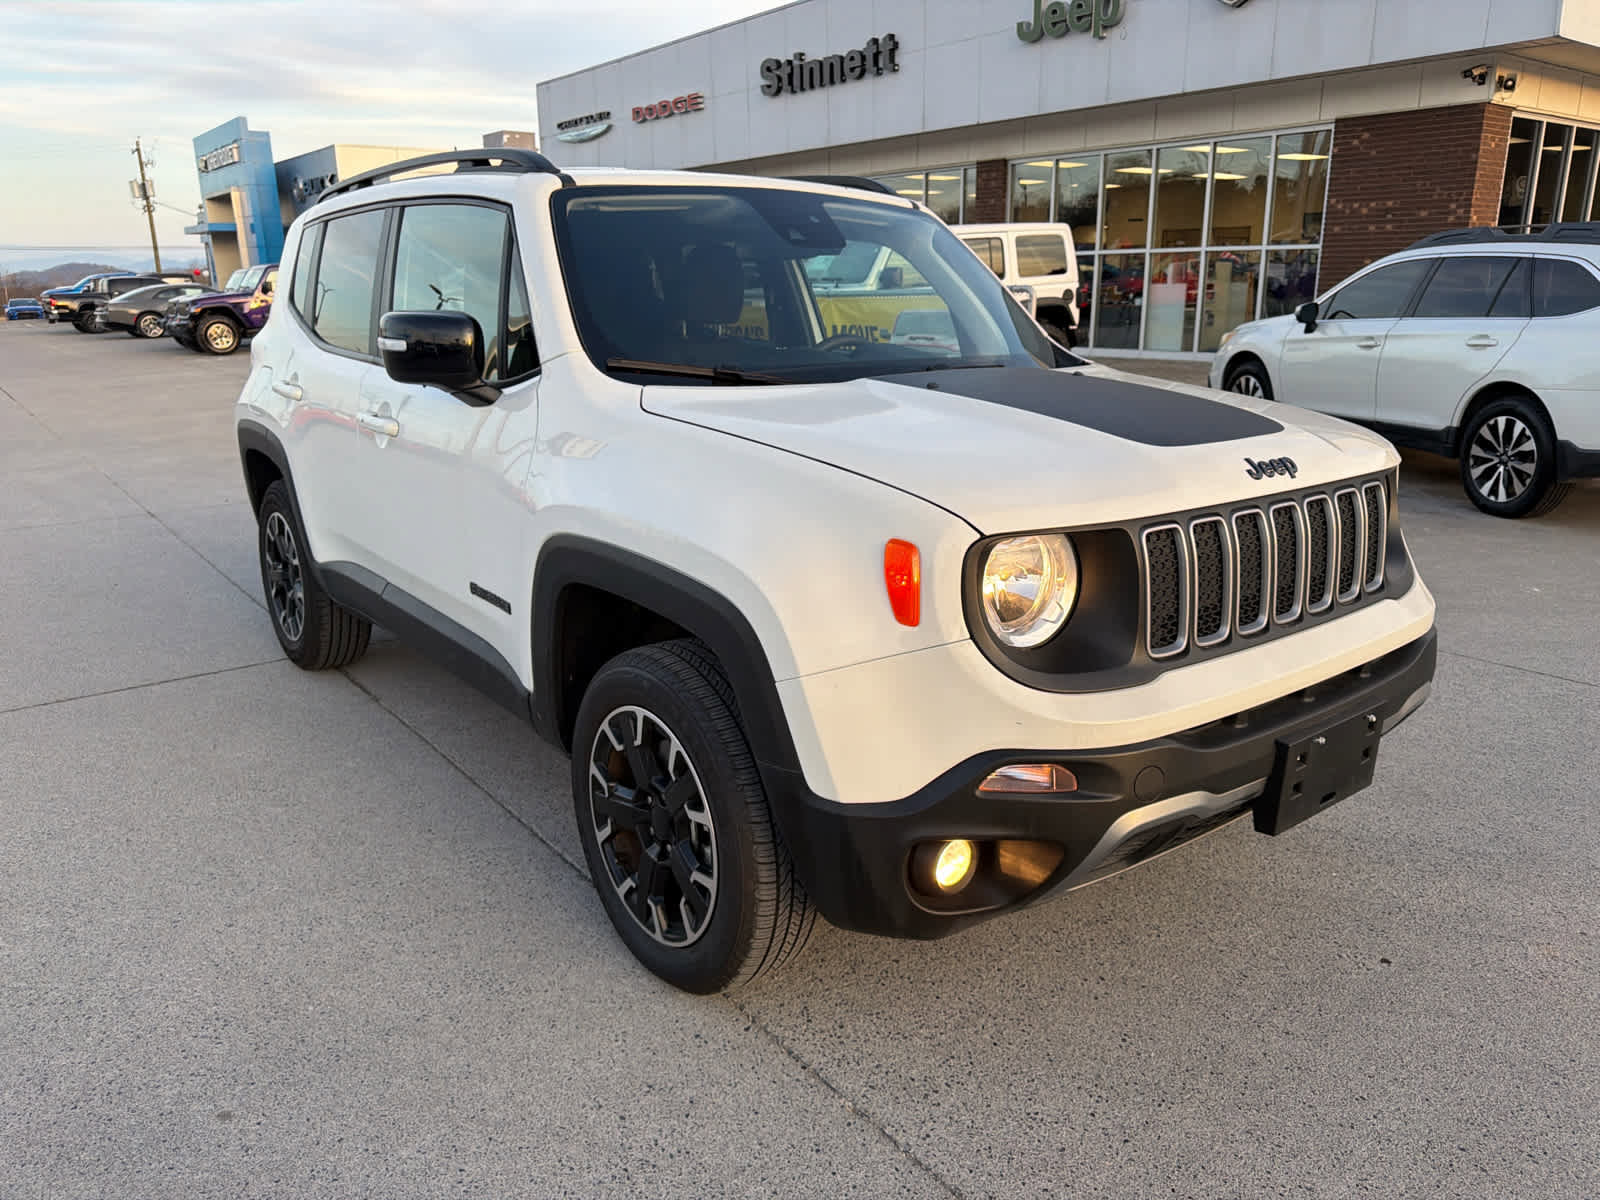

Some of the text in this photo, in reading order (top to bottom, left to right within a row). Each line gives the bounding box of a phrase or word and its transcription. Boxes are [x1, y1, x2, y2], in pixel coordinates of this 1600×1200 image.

[1016, 0, 1124, 43] Jeep
[760, 32, 899, 97] Stinnett
[631, 92, 705, 124] DODGE
[1243, 456, 1298, 481] Jeep
